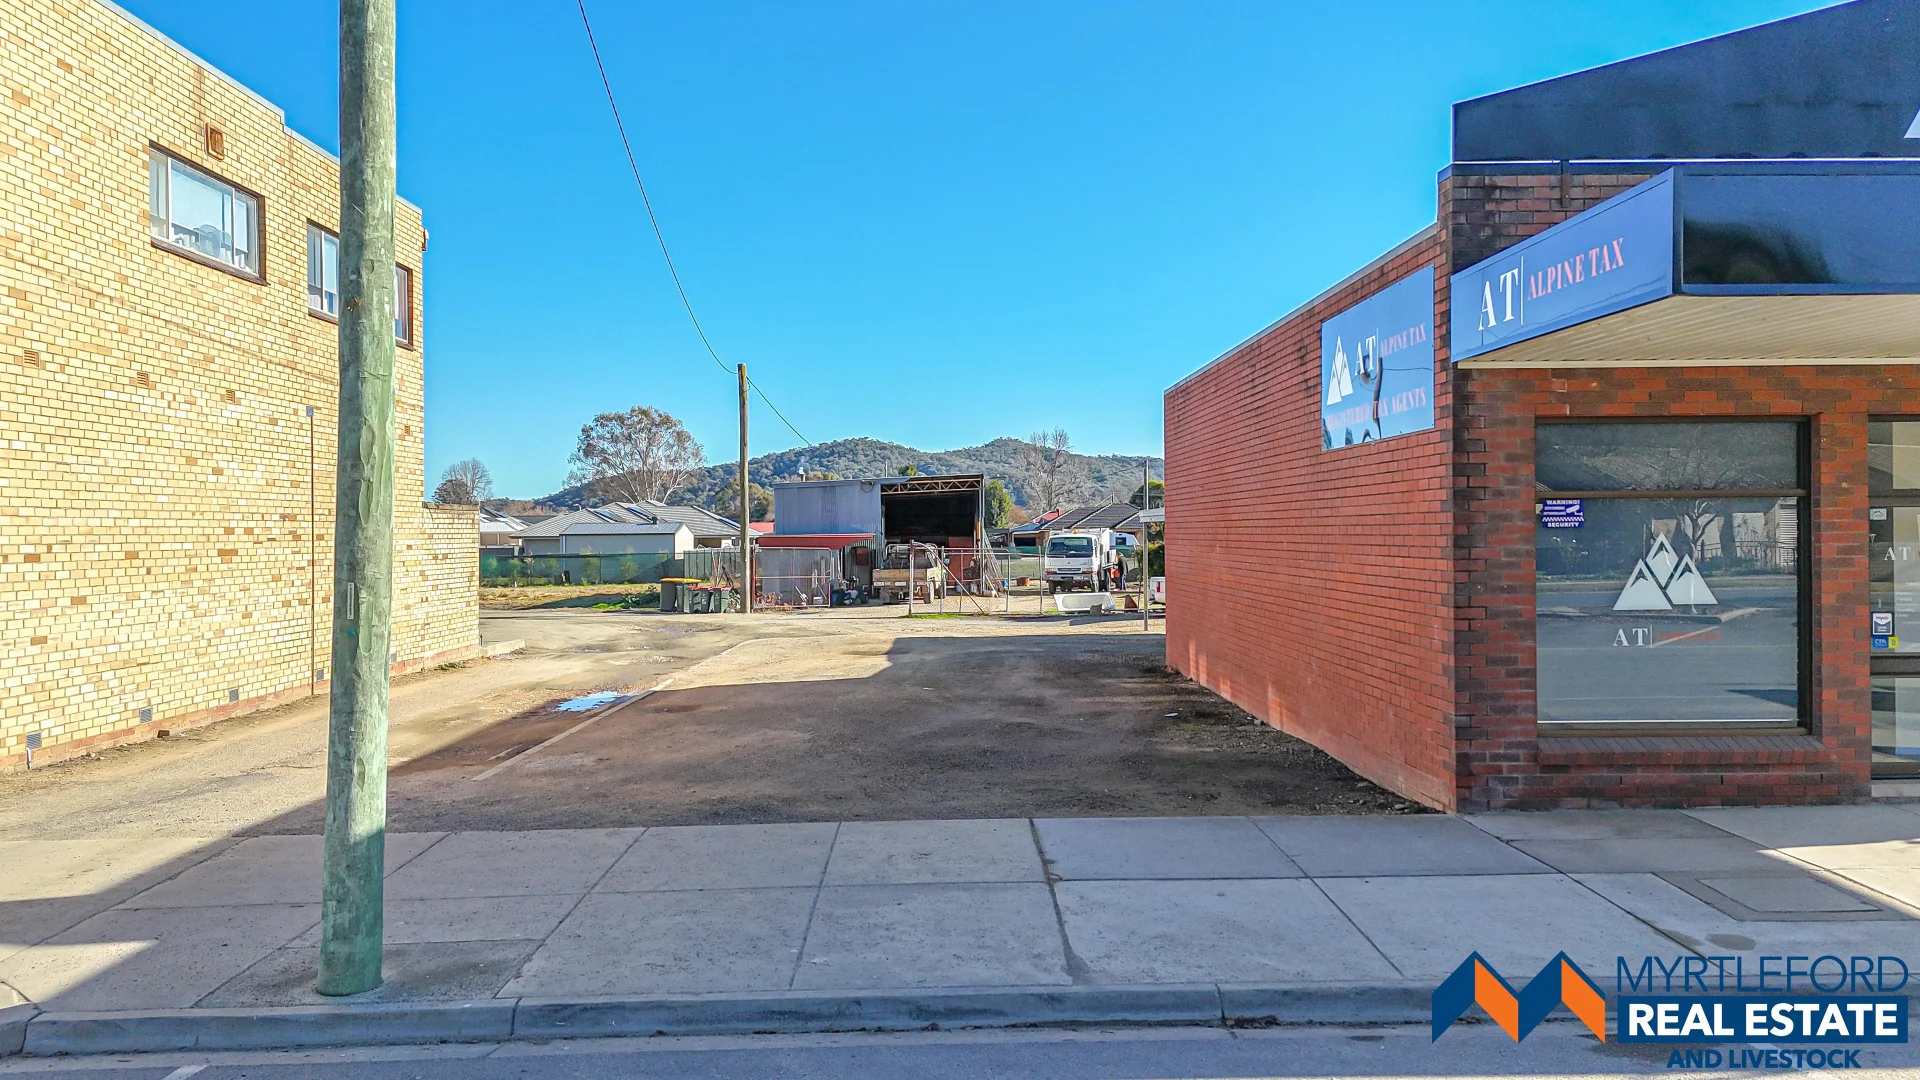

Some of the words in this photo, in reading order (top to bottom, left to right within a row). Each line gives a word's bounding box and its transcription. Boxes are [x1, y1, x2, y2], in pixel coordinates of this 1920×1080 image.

[1478, 267, 1519, 331] AT
[1527, 253, 1585, 300] ALPINE
[1588, 237, 1625, 278] TAX
[1354, 335, 1376, 376] AT
[1380, 328, 1408, 357] ALPINE
[1409, 322, 1427, 346] TAX
[1391, 386, 1427, 415] AGENTS
[1883, 546, 1911, 561] AT
[1612, 627, 1649, 647] AT
